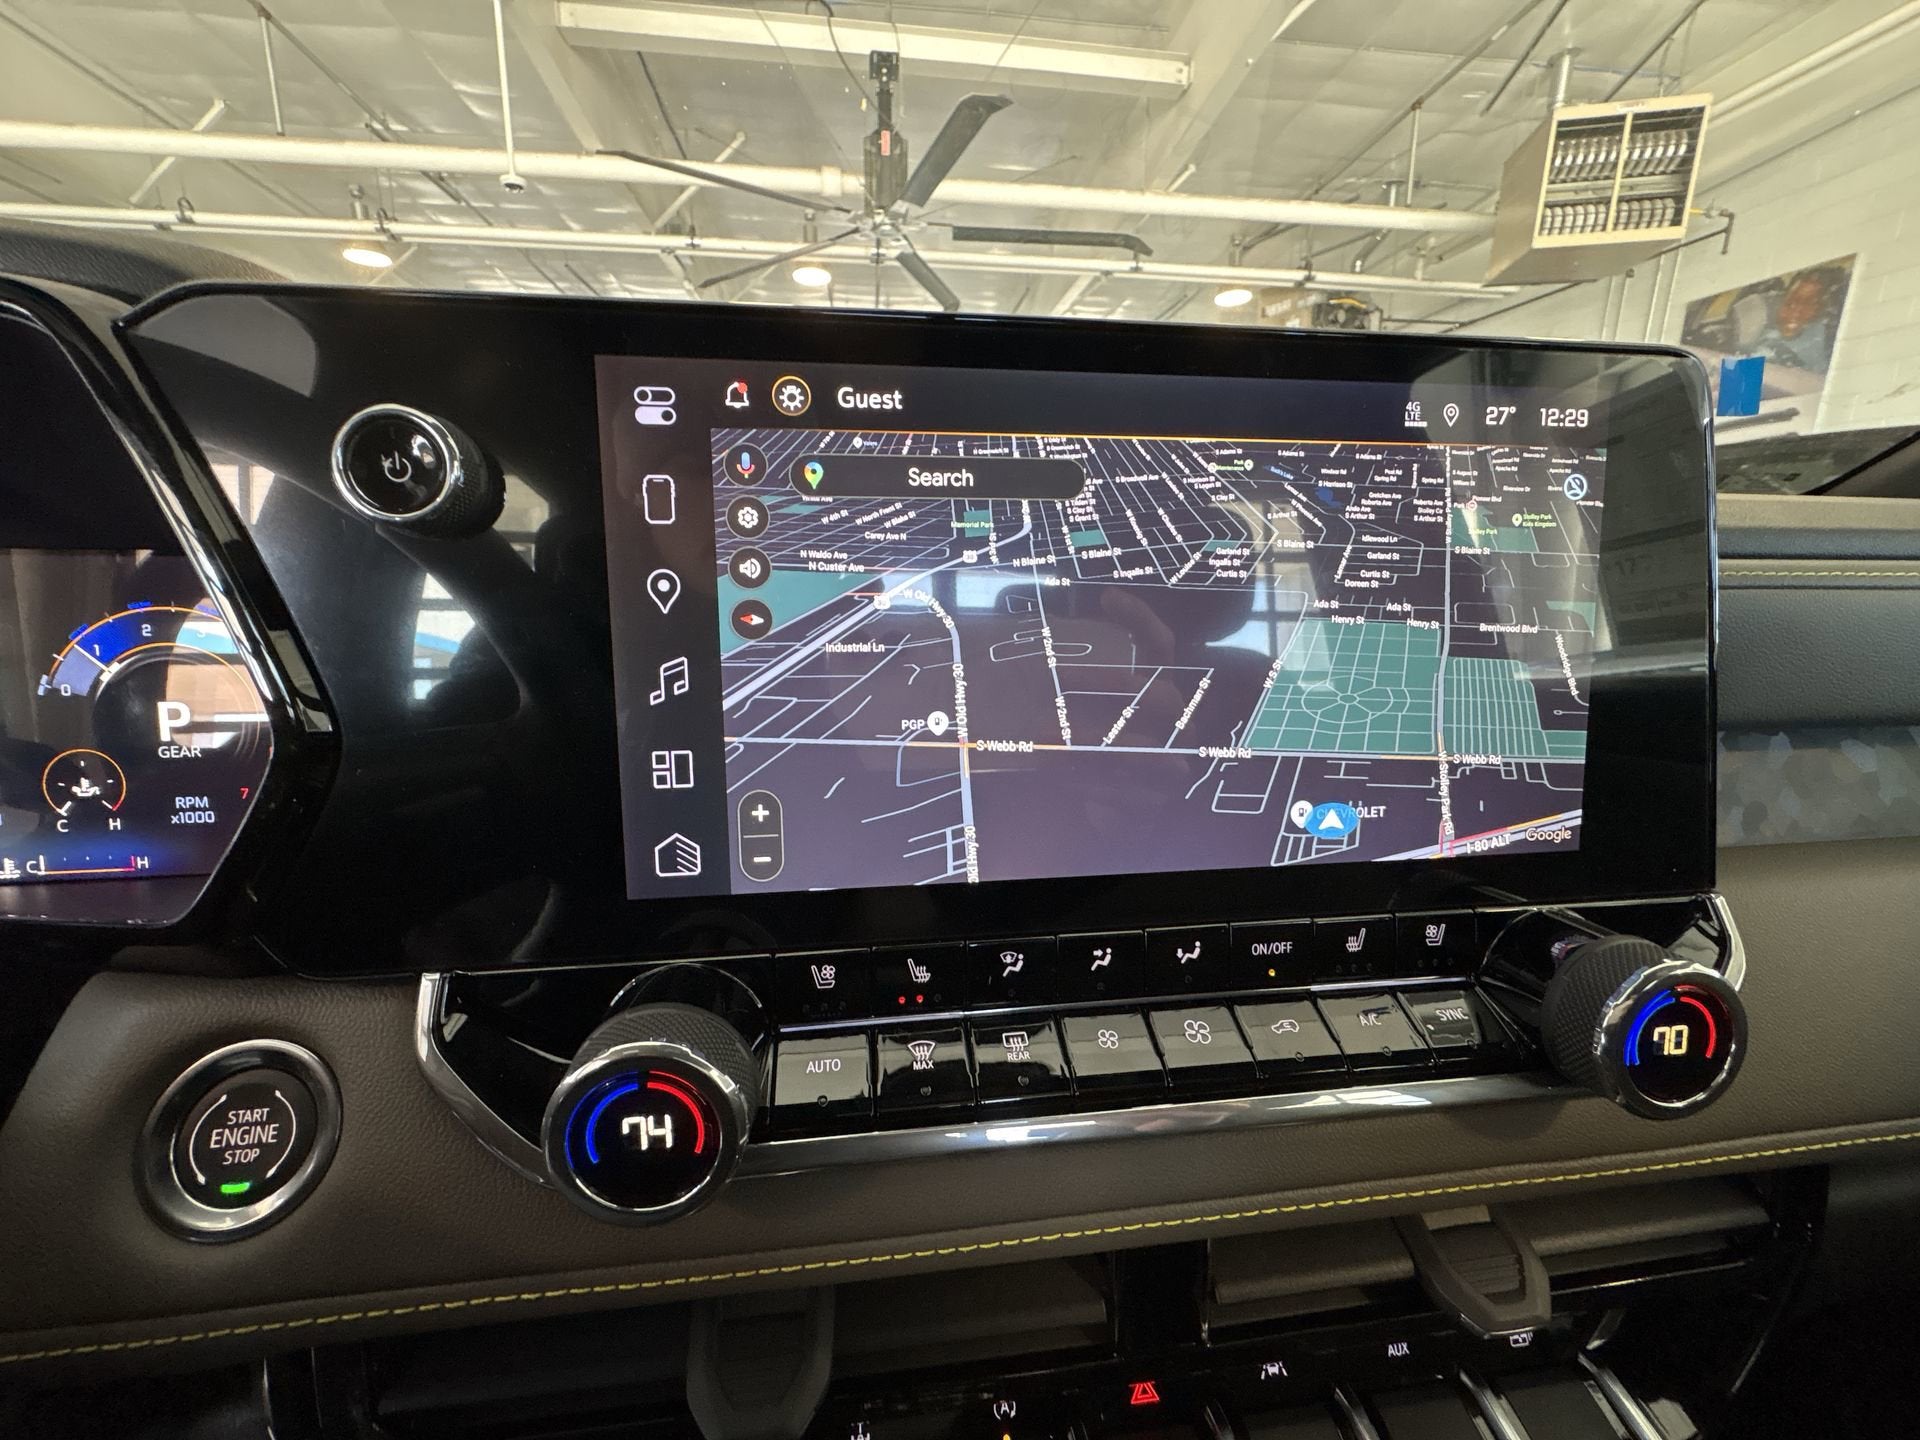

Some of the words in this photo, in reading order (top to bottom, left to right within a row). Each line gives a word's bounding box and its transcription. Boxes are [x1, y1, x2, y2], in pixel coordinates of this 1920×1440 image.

[838, 386, 902, 410] Guest
[1405, 402, 1421, 411] 4G
[1405, 411, 1421, 421] LTE
[1486, 406, 1516, 425] 27°
[1540, 408, 1588, 427] 12:29
[908, 468, 974, 486] Search
[821, 517, 829, 525] W
[830, 512, 840, 522] 4th
[840, 510, 848, 518] St
[1284, 540, 1305, 548] Blaine
[1362, 535, 1389, 543] Idlewood
[800, 550, 807, 558] N
[808, 550, 832, 559] Waldo
[1081, 551, 1088, 559] S
[1089, 549, 1112, 558] Blaine
[808, 562, 816, 570] N
[818, 563, 846, 571] Custer
[848, 564, 864, 572] Ave
[1013, 559, 1020, 567] N
[1022, 557, 1045, 566] Blaine
[1047, 555, 1055, 563] St
[1120, 569, 1143, 578] Ingalls
[1216, 570, 1238, 578] Curtis
[1061, 578, 1070, 586] St
[1371, 580, 1379, 588] St
[904, 588, 913, 599] W
[915, 590, 930, 601] Old
[929, 598, 946, 617] Hwy
[942, 615, 954, 629] 30
[1403, 603, 1411, 611] St
[1332, 615, 1354, 625] Henry
[1407, 618, 1429, 629] Henry
[1431, 621, 1439, 629] St
[142, 624, 152, 636] 2
[1042, 626, 1051, 637] W
[1480, 624, 1520, 633] Brentwood
[1522, 624, 1538, 633] Blvd
[93, 644, 100, 656] 1
[826, 643, 871, 652] Industrial
[873, 643, 884, 652] Ln
[1043, 638, 1056, 656] 2nd
[1048, 657, 1056, 668] St
[1555, 634, 1572, 678] Woodridge
[1568, 677, 1579, 696] Blvd
[952, 663, 964, 678] 30
[1263, 676, 1273, 688] W
[1269, 670, 1277, 678] S
[1273, 659, 1283, 670] St
[60, 684, 71, 696] 0
[955, 681, 967, 703] Hwy
[1055, 696, 1065, 707] W
[1175, 689, 1204, 730] Bachman
[1199, 678, 1211, 691] St
[157, 701, 191, 741] P
[955, 704, 967, 725] Old
[1057, 707, 1070, 728] 2nd
[901, 719, 925, 730] PGP
[1103, 715, 1127, 744] Lester
[1122, 706, 1135, 719] St
[957, 728, 968, 738] W
[1062, 728, 1071, 740] St
[976, 739, 984, 751] S
[987, 740, 1017, 751] Webb
[1018, 742, 1033, 752] Rd
[158, 746, 201, 759] GEAR
[1199, 747, 1207, 757] S
[1209, 747, 1236, 758] Webb
[1238, 748, 1252, 758] Rd
[1438, 750, 1447, 762] W
[1453, 754, 1461, 763] S
[1462, 754, 1487, 764] Webb
[1488, 754, 1502, 764] Rd
[1438, 764, 1450, 796] Stolley
[240, 788, 249, 800] 7
[175, 796, 209, 808] RPM
[1441, 799, 1451, 821] Park
[171, 811, 215, 824] x1000
[56, 819, 68, 832] C
[109, 818, 121, 831] H
[1444, 822, 1454, 835] Rd
[1525, 827, 1572, 843] Google
[1466, 839, 1489, 854] I-80
[1491, 833, 1511, 848] ALT
[26, 861, 37, 873] C
[137, 857, 148, 869] H
[1251, 940, 1293, 956] ON/OFF
[1360, 1013, 1381, 1026] A/C
[1435, 1007, 1469, 1022] SYNC
[1653, 1025, 1689, 1055] 70
[1007, 1050, 1031, 1062] REAR
[806, 1059, 841, 1074] AUTO
[912, 1060, 934, 1071] MAX
[227, 1108, 270, 1125] START
[210, 1124, 279, 1149] ENGINE
[622, 1114, 672, 1151] 74
[222, 1148, 260, 1165] STOP
[1388, 1342, 1410, 1357] AUX
